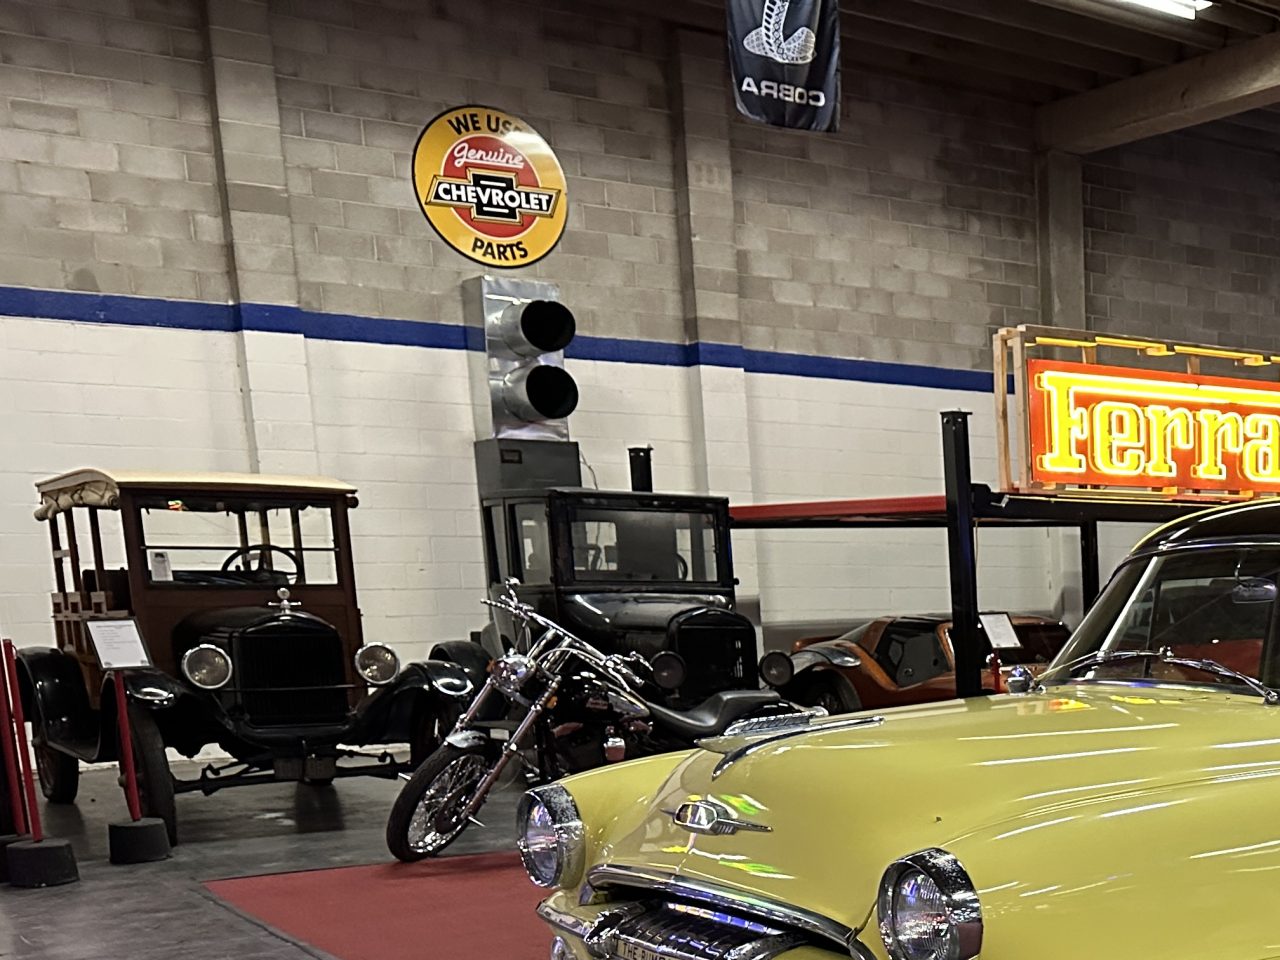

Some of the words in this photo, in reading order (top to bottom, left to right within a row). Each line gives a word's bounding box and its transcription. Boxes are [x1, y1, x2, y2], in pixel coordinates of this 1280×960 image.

[447, 113, 482, 136] WE
[453, 142, 525, 168] Genuine
[437, 182, 550, 211] CHEVROLET
[471, 237, 529, 261] PARTS
[622, 942, 638, 960] THE
